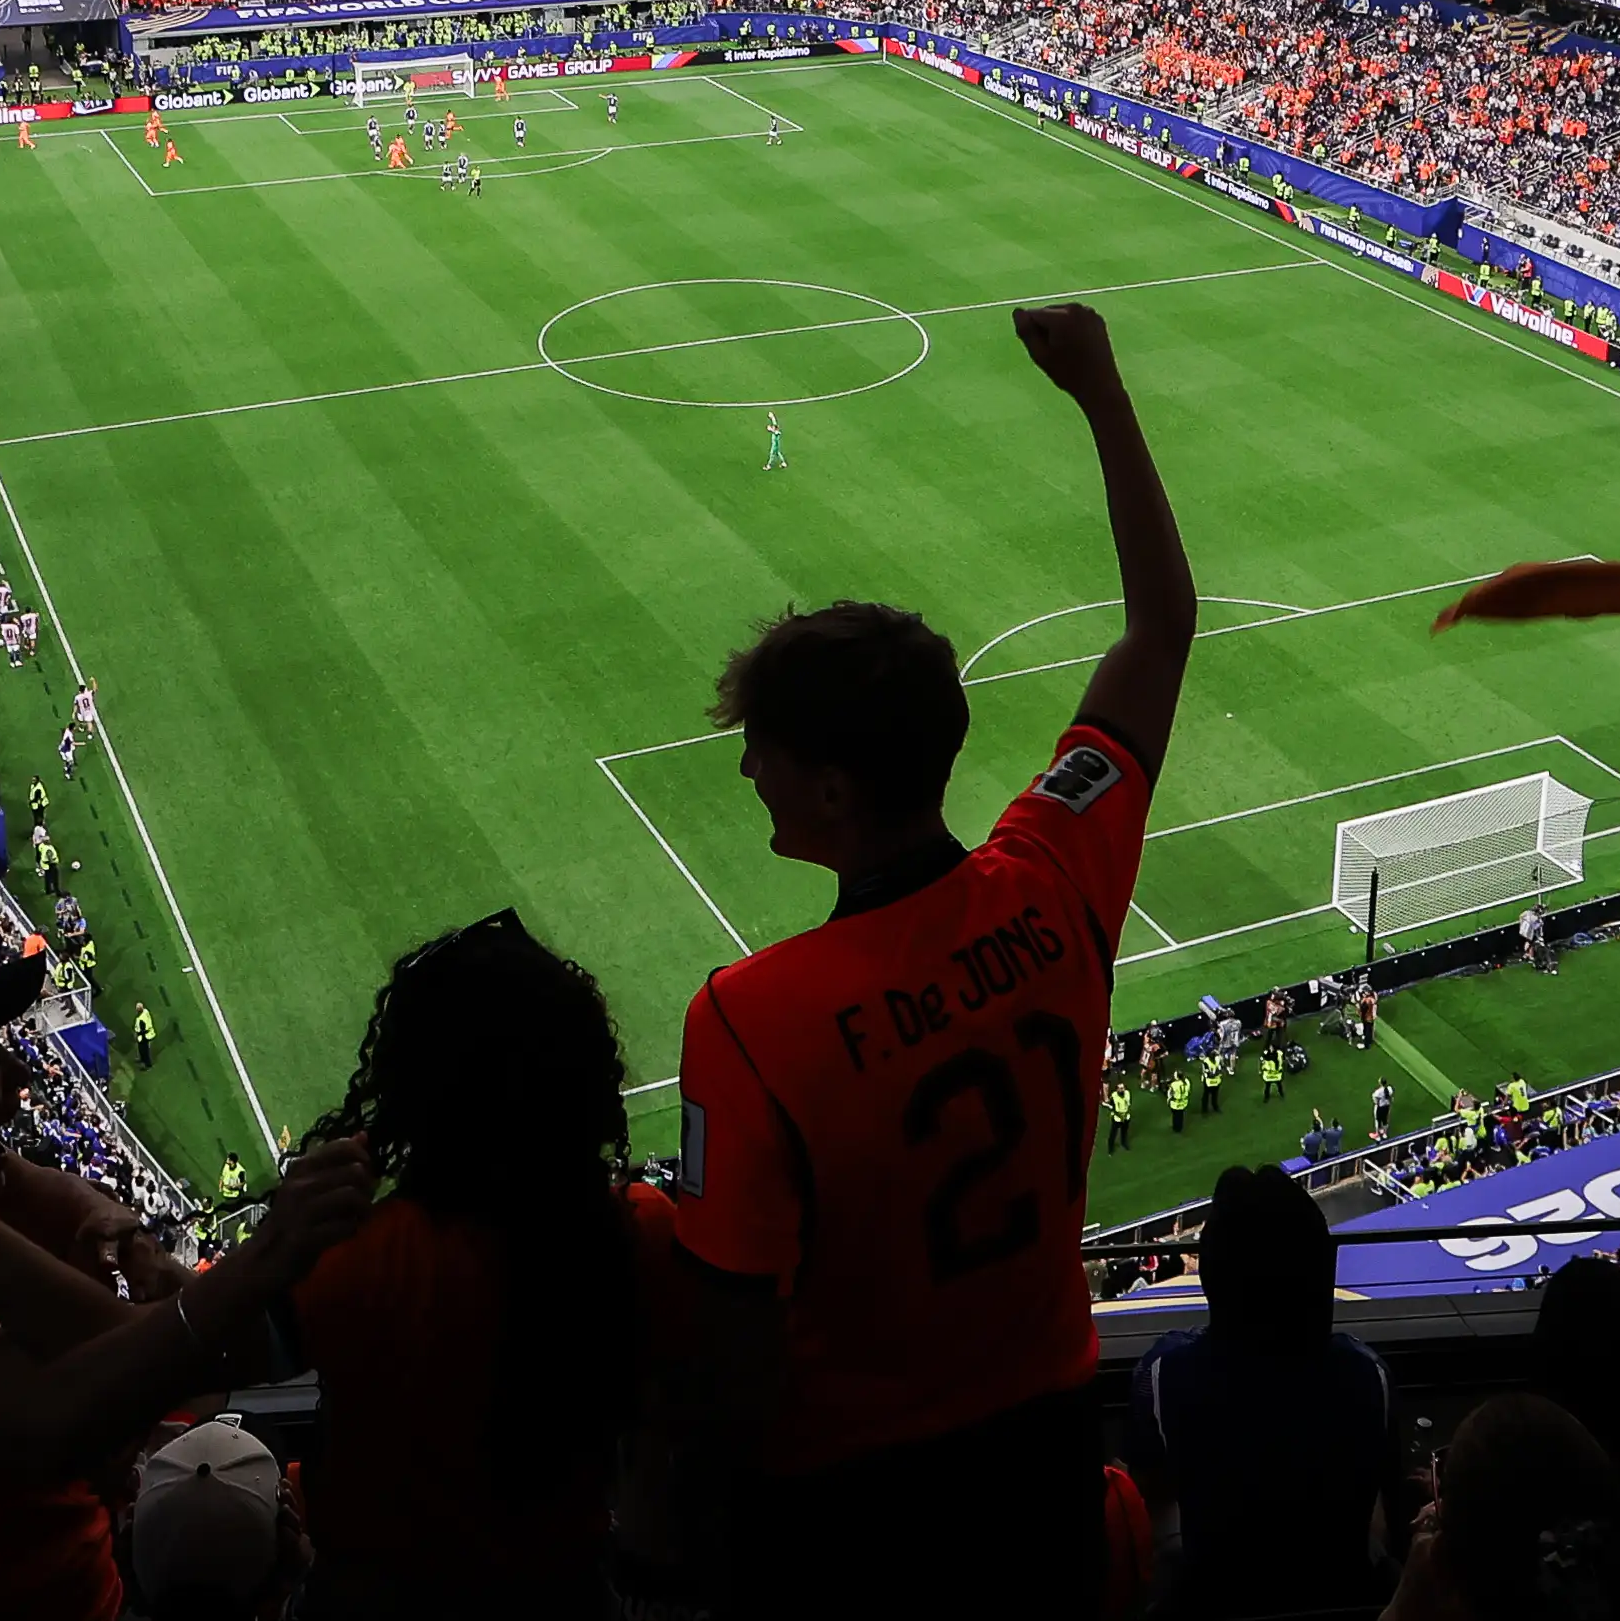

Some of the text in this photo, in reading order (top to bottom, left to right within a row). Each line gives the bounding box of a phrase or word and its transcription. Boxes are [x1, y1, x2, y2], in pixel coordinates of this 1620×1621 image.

[236, 3, 302, 20] FIFA
[734, 50, 757, 61] Inter
[917, 47, 965, 79] Valvoline.
[508, 62, 558, 79] GAMES
[564, 58, 614, 75] GROUP
[243, 83, 309, 104] Globant
[330, 77, 396, 96] Globant
[983, 75, 1015, 101] Globant
[154, 90, 222, 111] Globant
[1074, 115, 1172, 169] SAVVY GAMES GROUP
[1211, 175, 1229, 193] Inter
[1320, 223, 1337, 240] FIFA
[1337, 230, 1364, 252] WORLD
[1365, 243, 1382, 260] CUP
[1489, 291, 1579, 348] Valvoline.
[884, 982, 953, 1047] De
[950, 905, 1066, 1013] JONG
[899, 1008, 1087, 1288] 21
